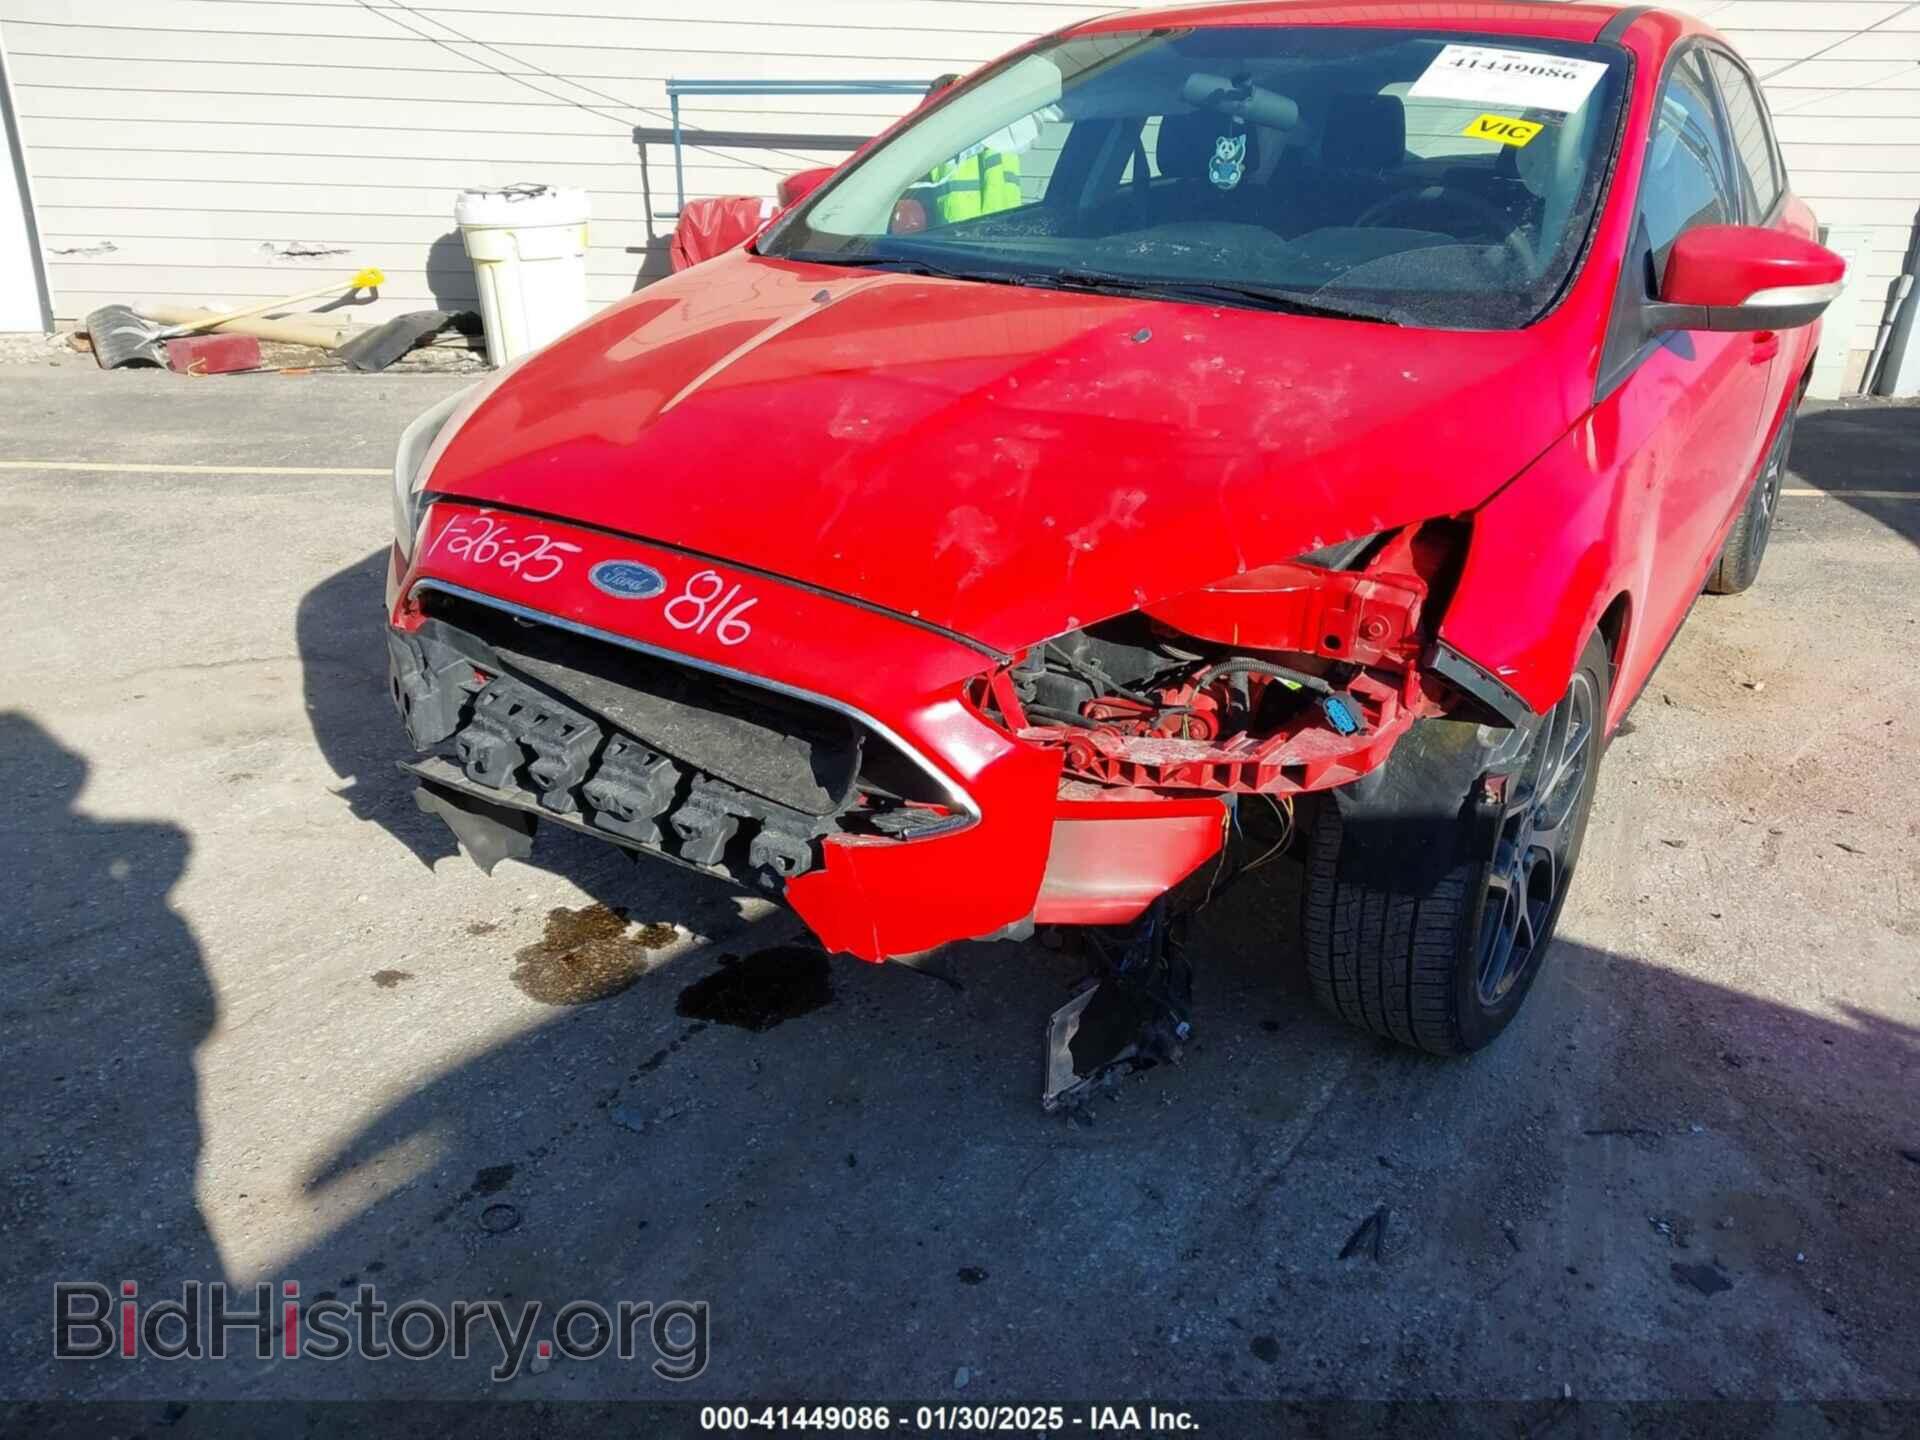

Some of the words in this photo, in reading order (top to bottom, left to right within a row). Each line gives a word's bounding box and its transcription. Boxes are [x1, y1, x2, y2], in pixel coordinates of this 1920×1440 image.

[1449, 58, 1577, 80] 41449086
[1479, 119, 1532, 139] VIC
[603, 566, 649, 592] Ford
